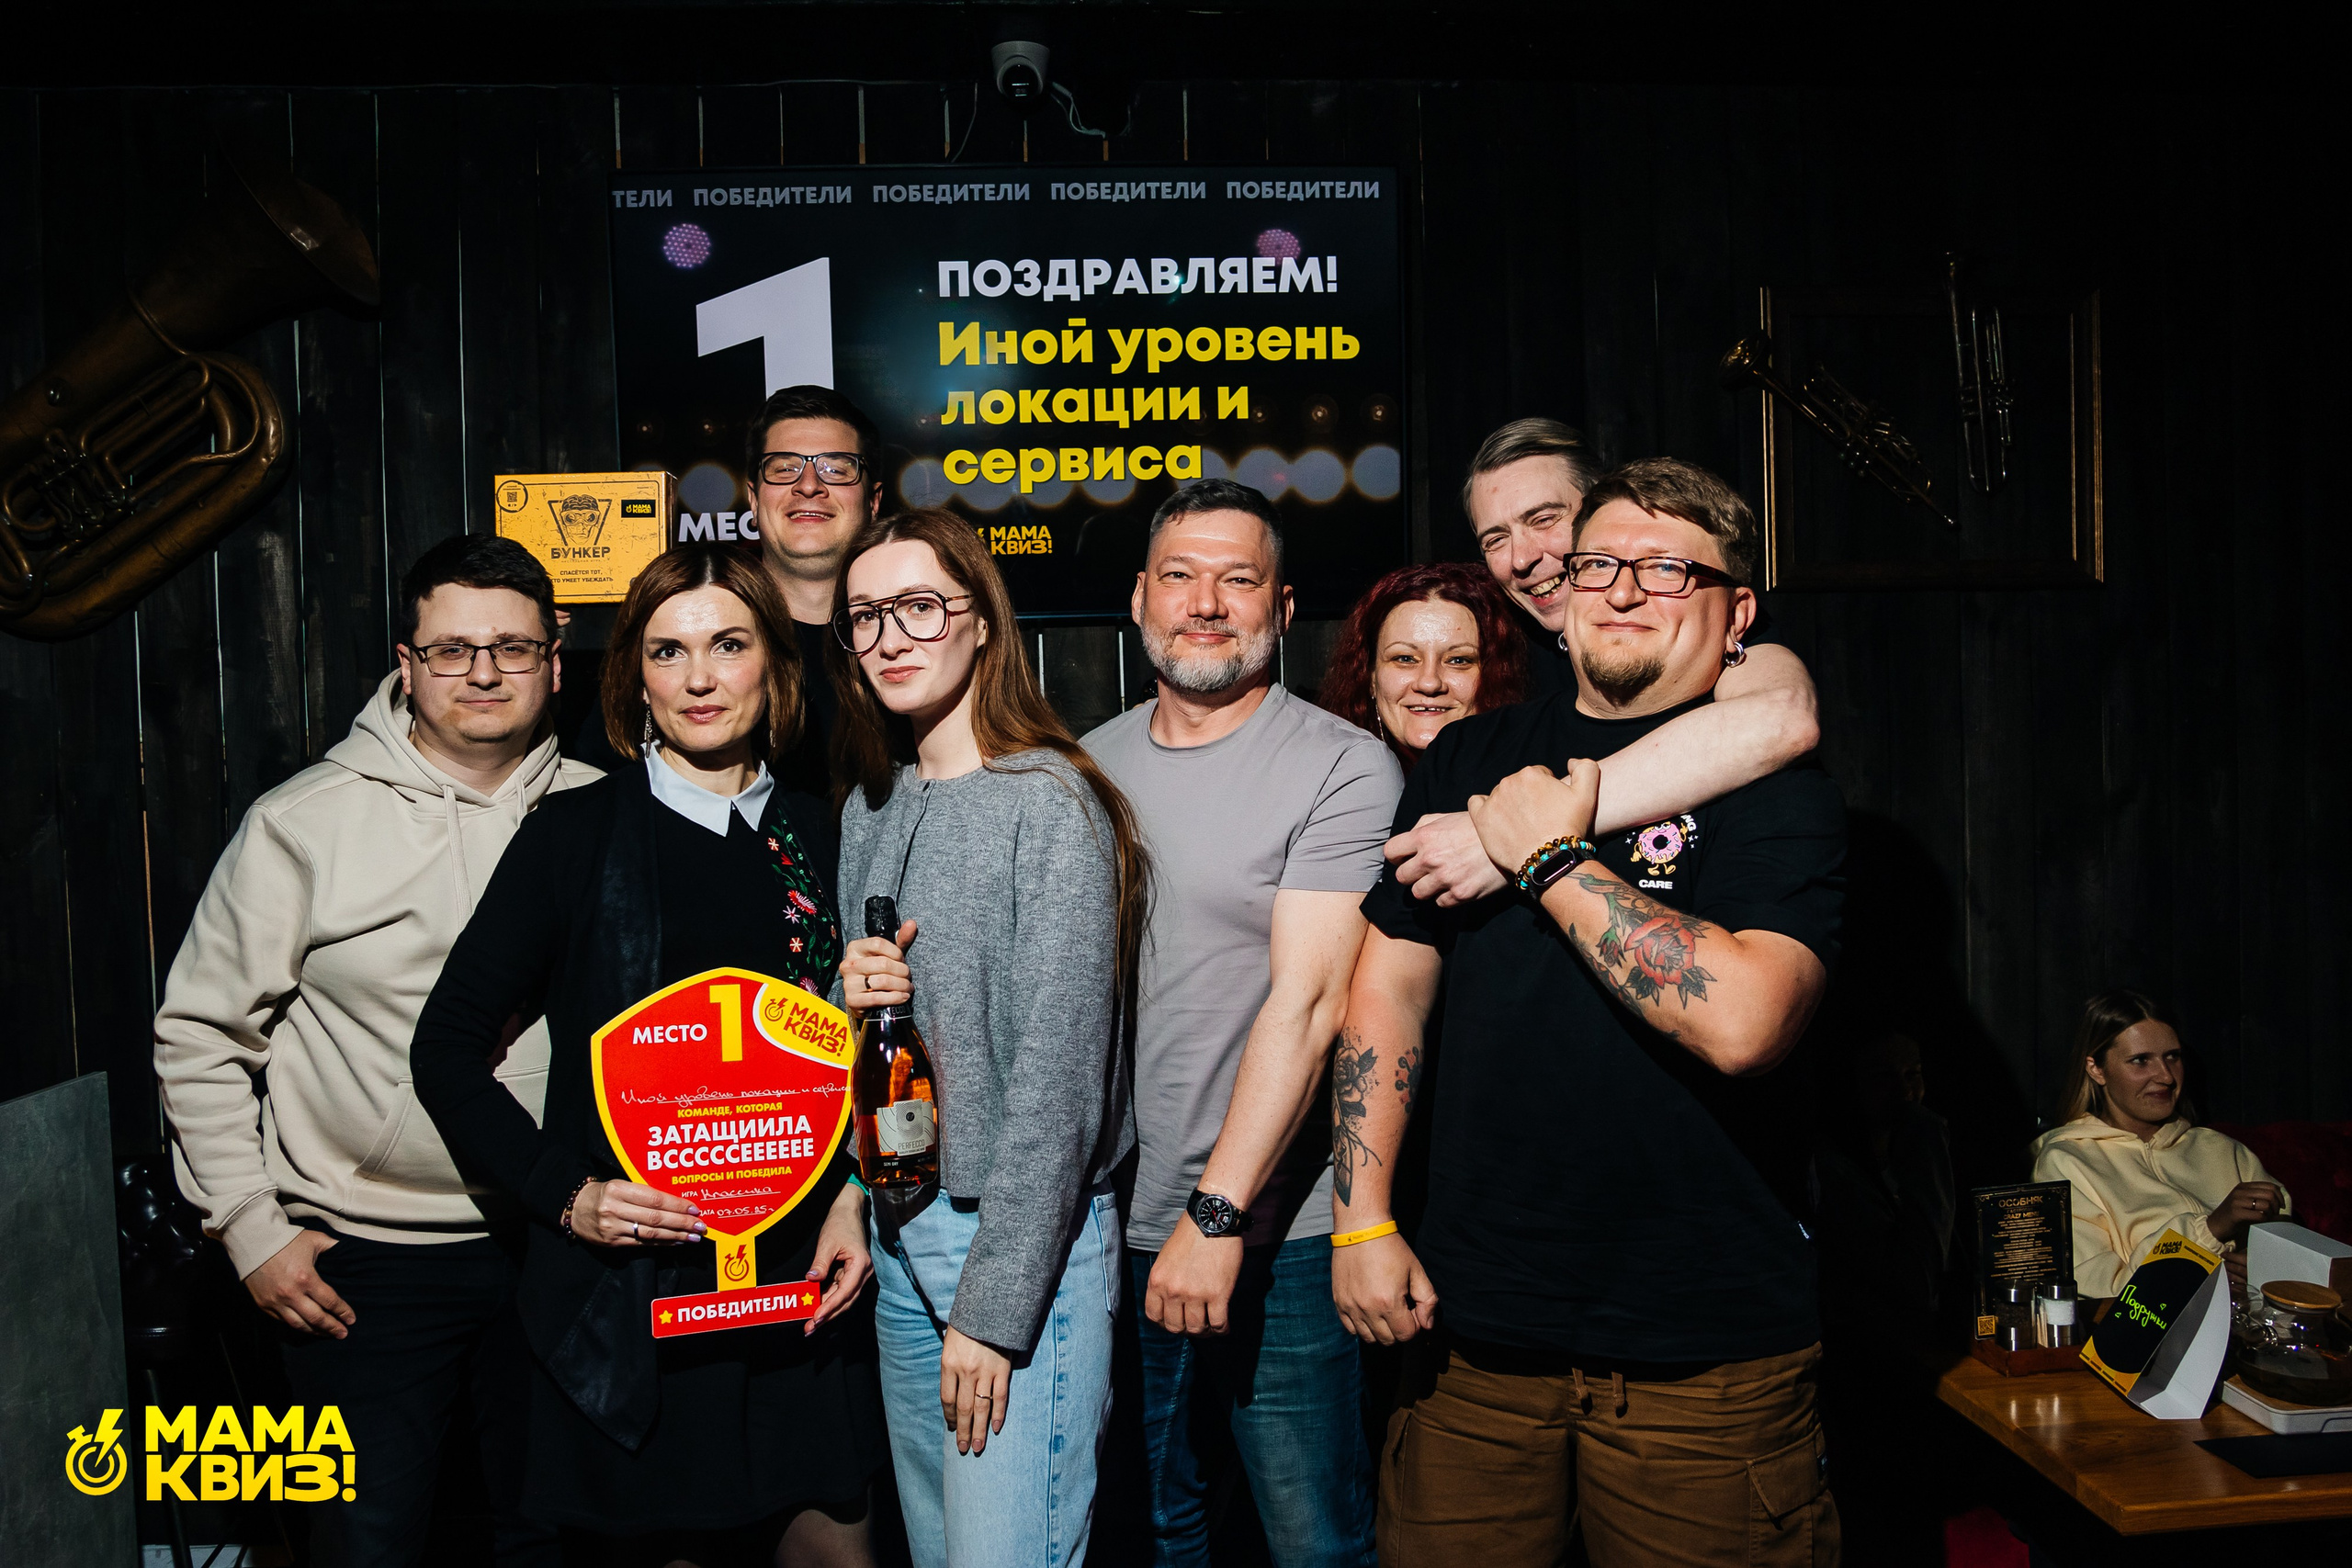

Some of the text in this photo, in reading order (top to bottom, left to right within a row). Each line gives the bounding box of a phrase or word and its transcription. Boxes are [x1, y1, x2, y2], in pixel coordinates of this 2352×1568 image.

[694, 186, 852, 208] ПОБЕДИТЕЛИ
[873, 184, 1030, 205] ПОБЕДИТЕЛИ
[1050, 182, 1206, 203] ПОБЕДИТЕЛИ
[1227, 181, 1380, 201] ПОБЕДИТЕЛИ
[938, 256, 1339, 301] ПОЗДРАВЛЯЕМ!
[695, 256, 834, 401] 1
[938, 318, 1361, 375] Иной уровень
[940, 387, 1250, 429] локации и
[943, 446, 1204, 493] сервиса
[678, 510, 761, 542] МЕС
[989, 525, 1052, 540] МАМА
[551, 547, 611, 559] БУНКЕР
[990, 539, 1053, 555] КВИЗ!
[1638, 878, 1674, 890] CARE
[632, 983, 743, 1063] МЕСТО 1
[783, 1016, 846, 1057] КВИЗ!
[789, 1001, 848, 1043] МАМА
[621, 1088, 668, 1104] Иной
[673, 1085, 734, 1108] уровень
[676, 1101, 784, 1119] КОМАНДЕ, КОТОРАЯ
[647, 1114, 813, 1147] ЗАТАЩИИЛА
[898, 1138, 925, 1150] PERFECCO
[647, 1137, 815, 1171] ВСССССЕЕЕЕЕЕ
[671, 1166, 793, 1186] ВОПРОСЫ И ПОБЕДИЛА
[1998, 1195, 2044, 1209] ОСОБНЯК
[677, 1293, 797, 1323] ПОБЕДИТЕЛИ
[2120, 1284, 2167, 1329] Подружки
